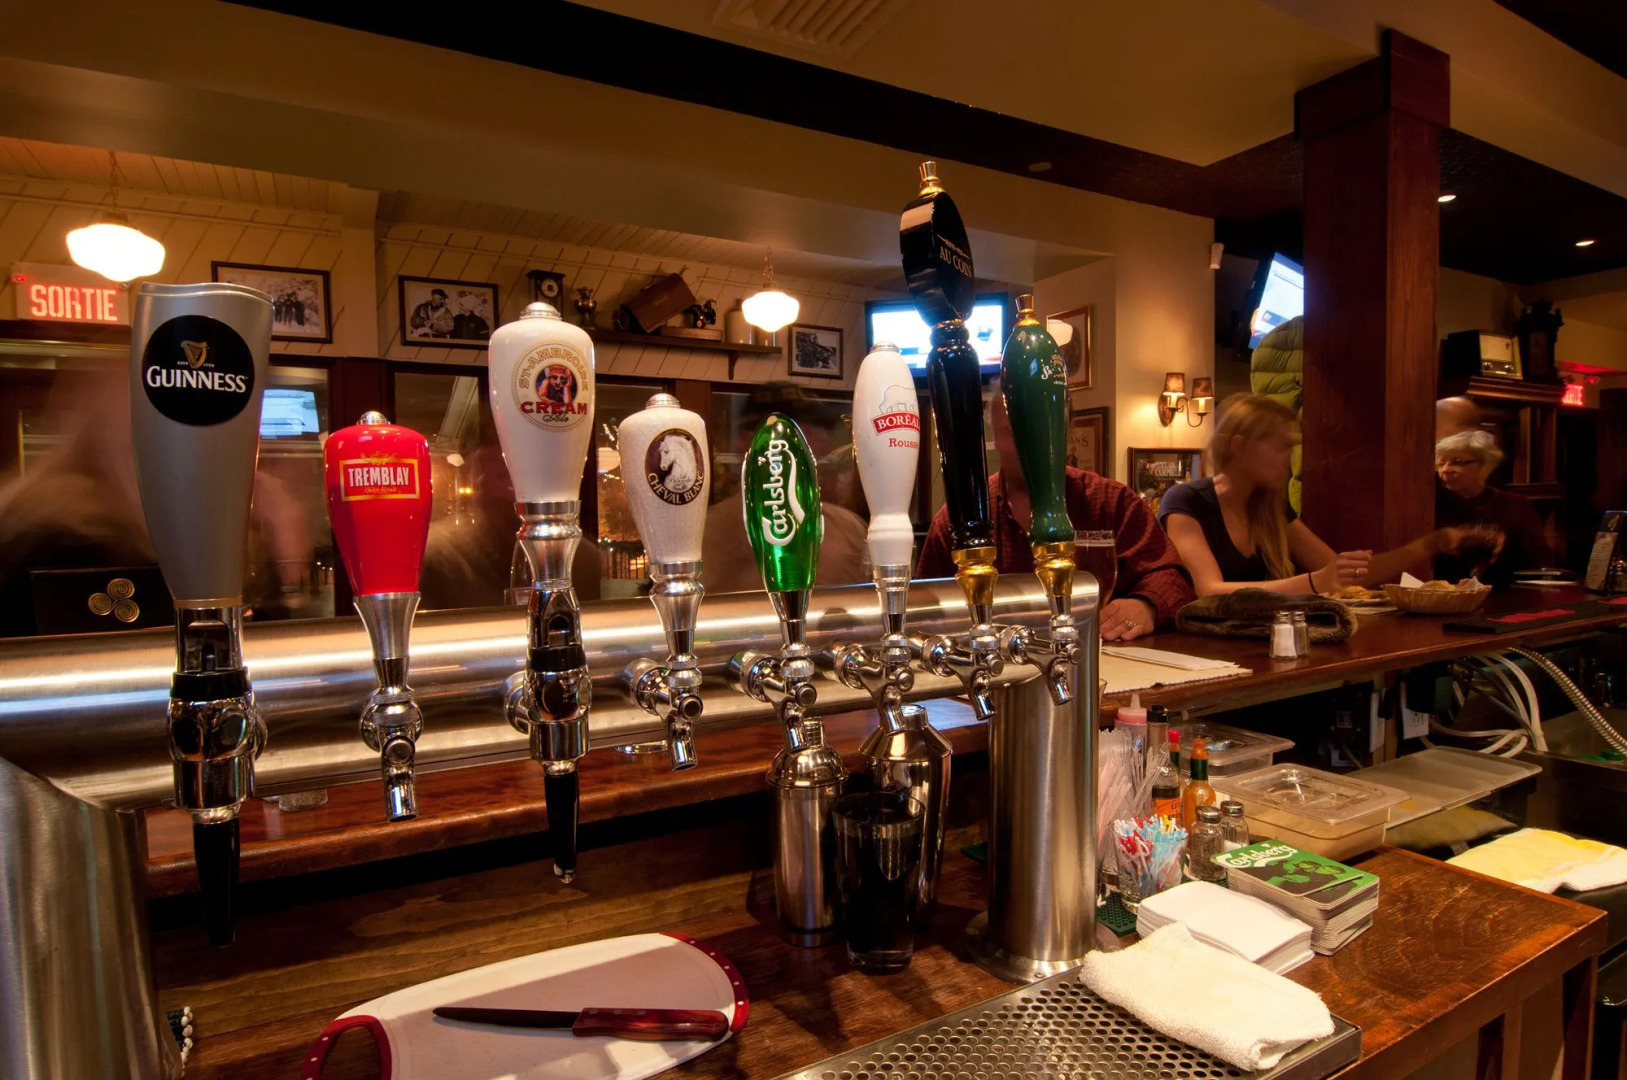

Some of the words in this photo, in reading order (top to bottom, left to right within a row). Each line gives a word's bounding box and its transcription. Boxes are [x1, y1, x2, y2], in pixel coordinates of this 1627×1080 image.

[31, 284, 118, 321] SORTIE
[147, 365, 247, 393] GUINNESS
[520, 401, 588, 415] CREAM
[348, 467, 410, 488] TREMBLAY
[648, 473, 683, 504] CHEVAL
[761, 440, 803, 546] Carlsberg
[1215, 843, 1298, 869] Carlsberg
